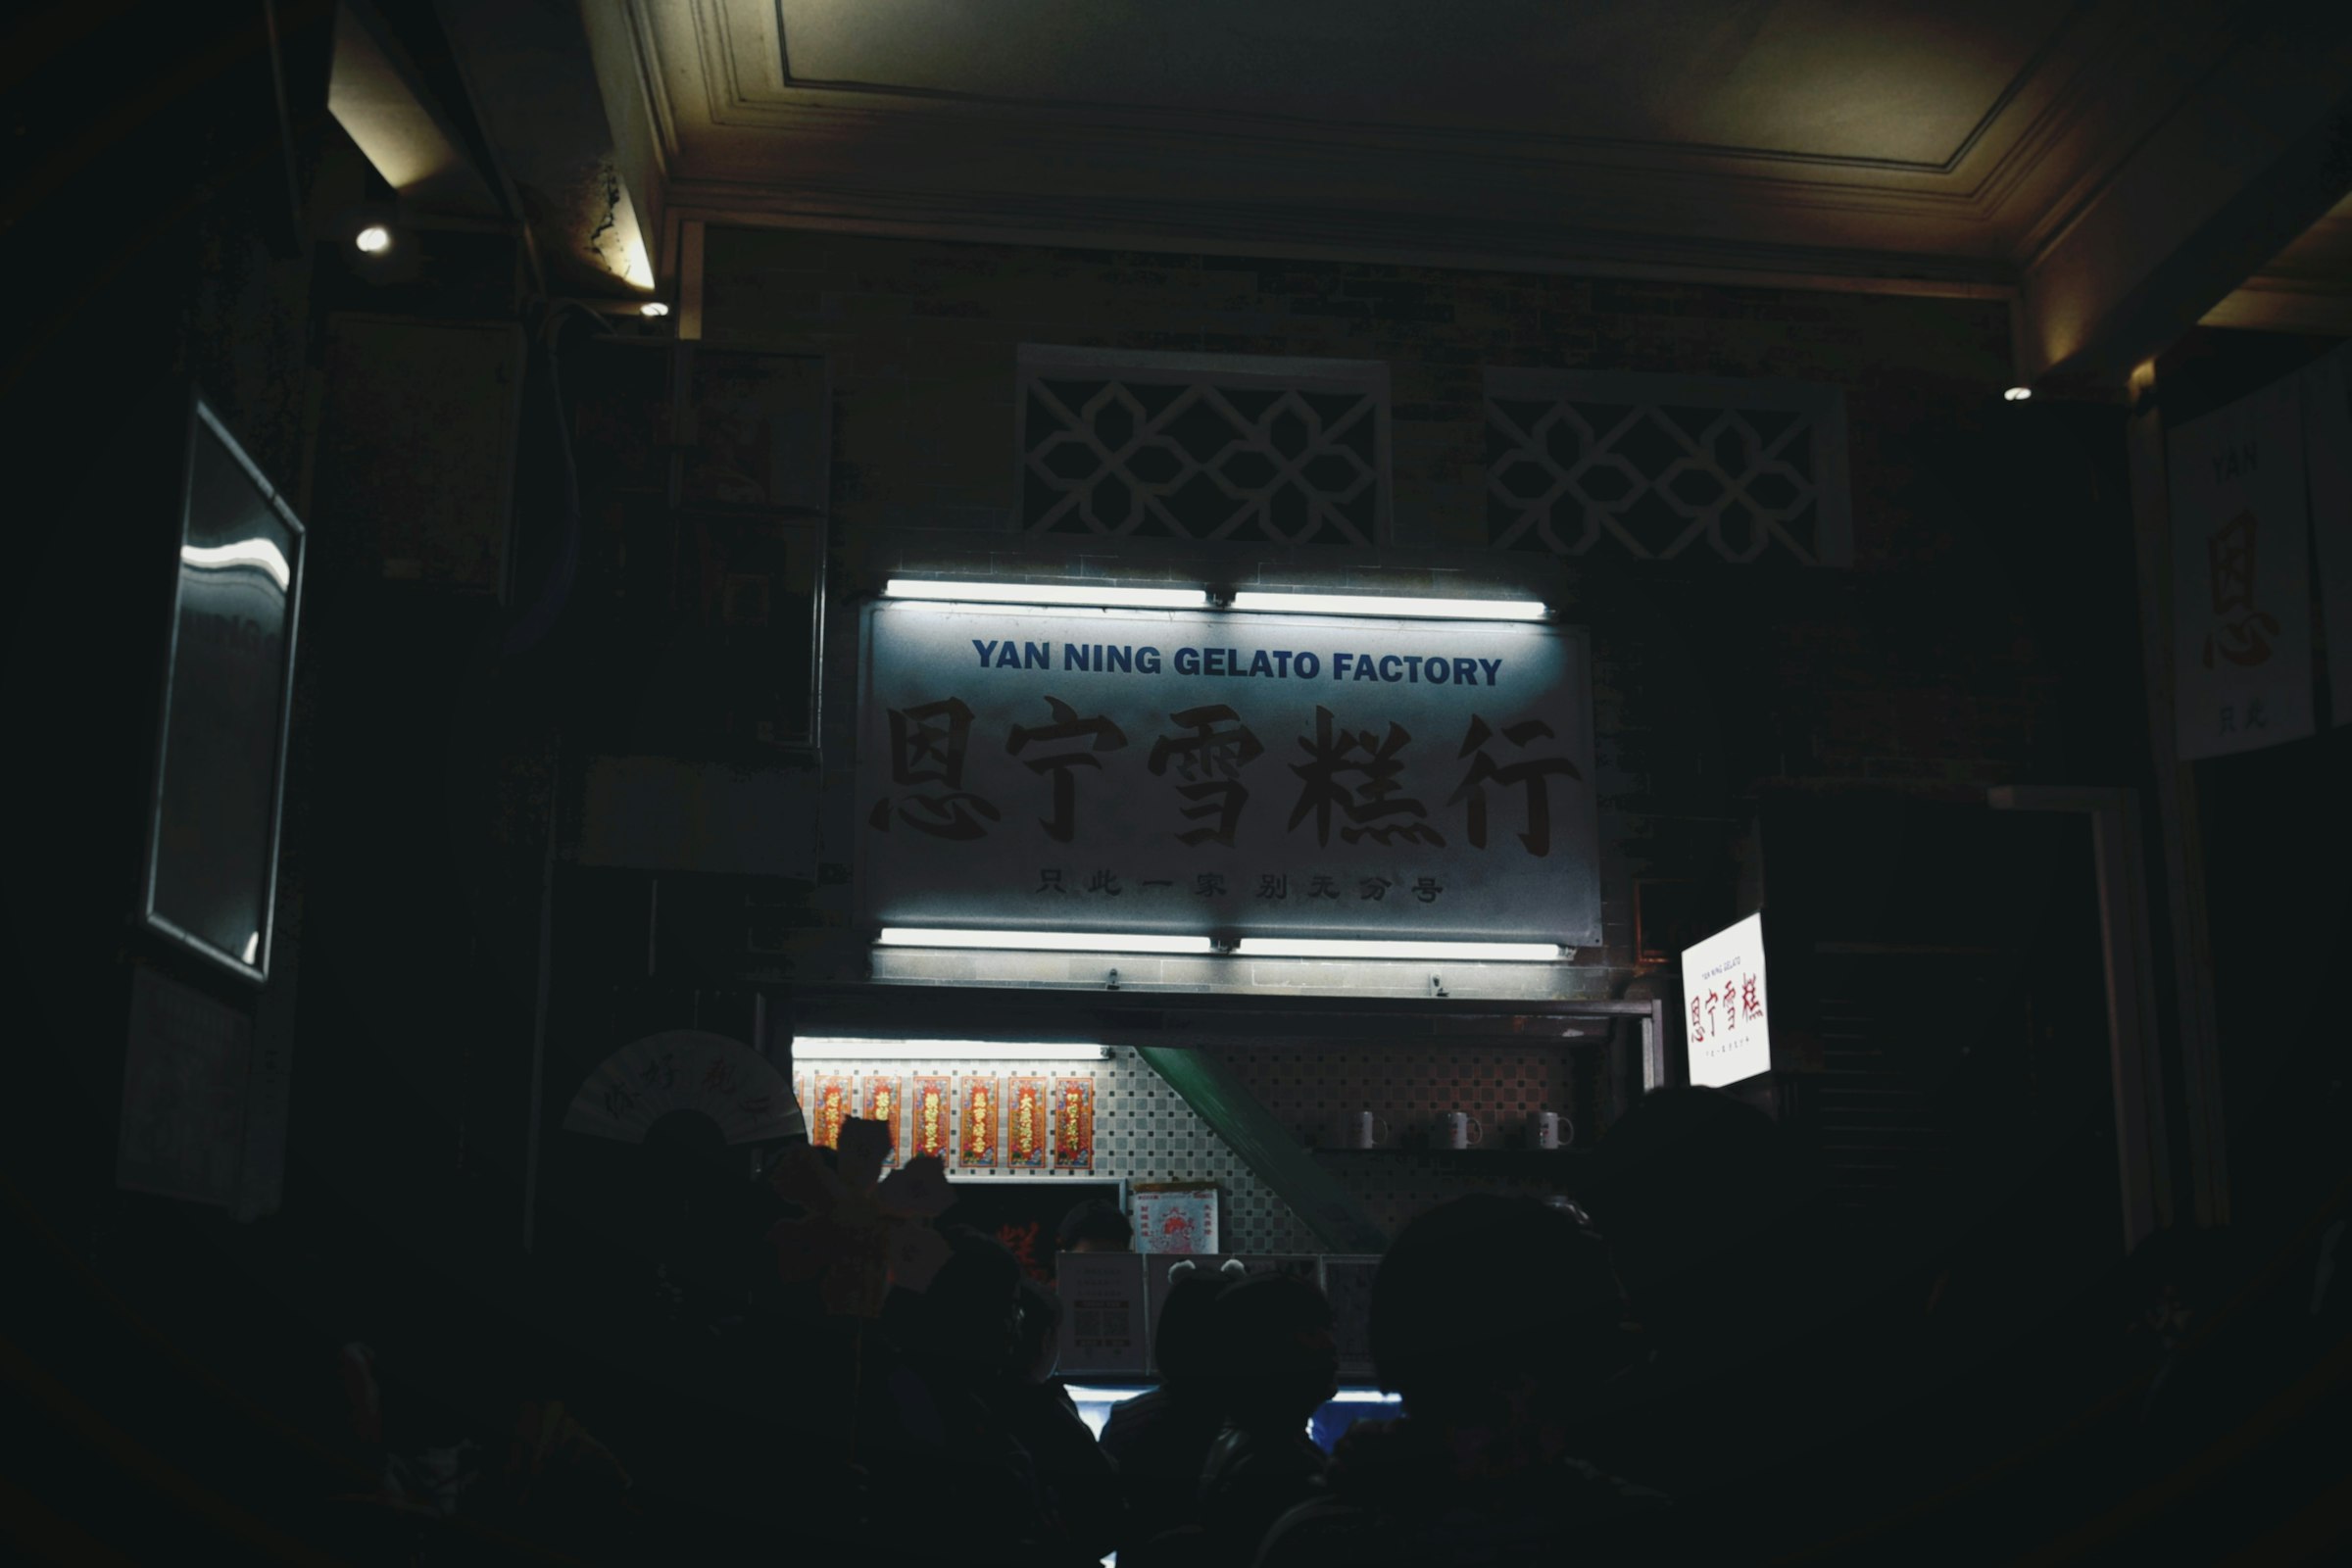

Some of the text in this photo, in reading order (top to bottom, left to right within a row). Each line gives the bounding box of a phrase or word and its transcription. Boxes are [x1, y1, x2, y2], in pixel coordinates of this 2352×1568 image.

[2211, 441, 2259, 485] YAN
[2202, 508, 2281, 671] 恩
[972, 639, 1503, 687] YAN NING GELATO FACTORY
[868, 695, 1582, 858] 恩宁雪糕行
[1690, 972, 1764, 1043] 恩宁雪糕
